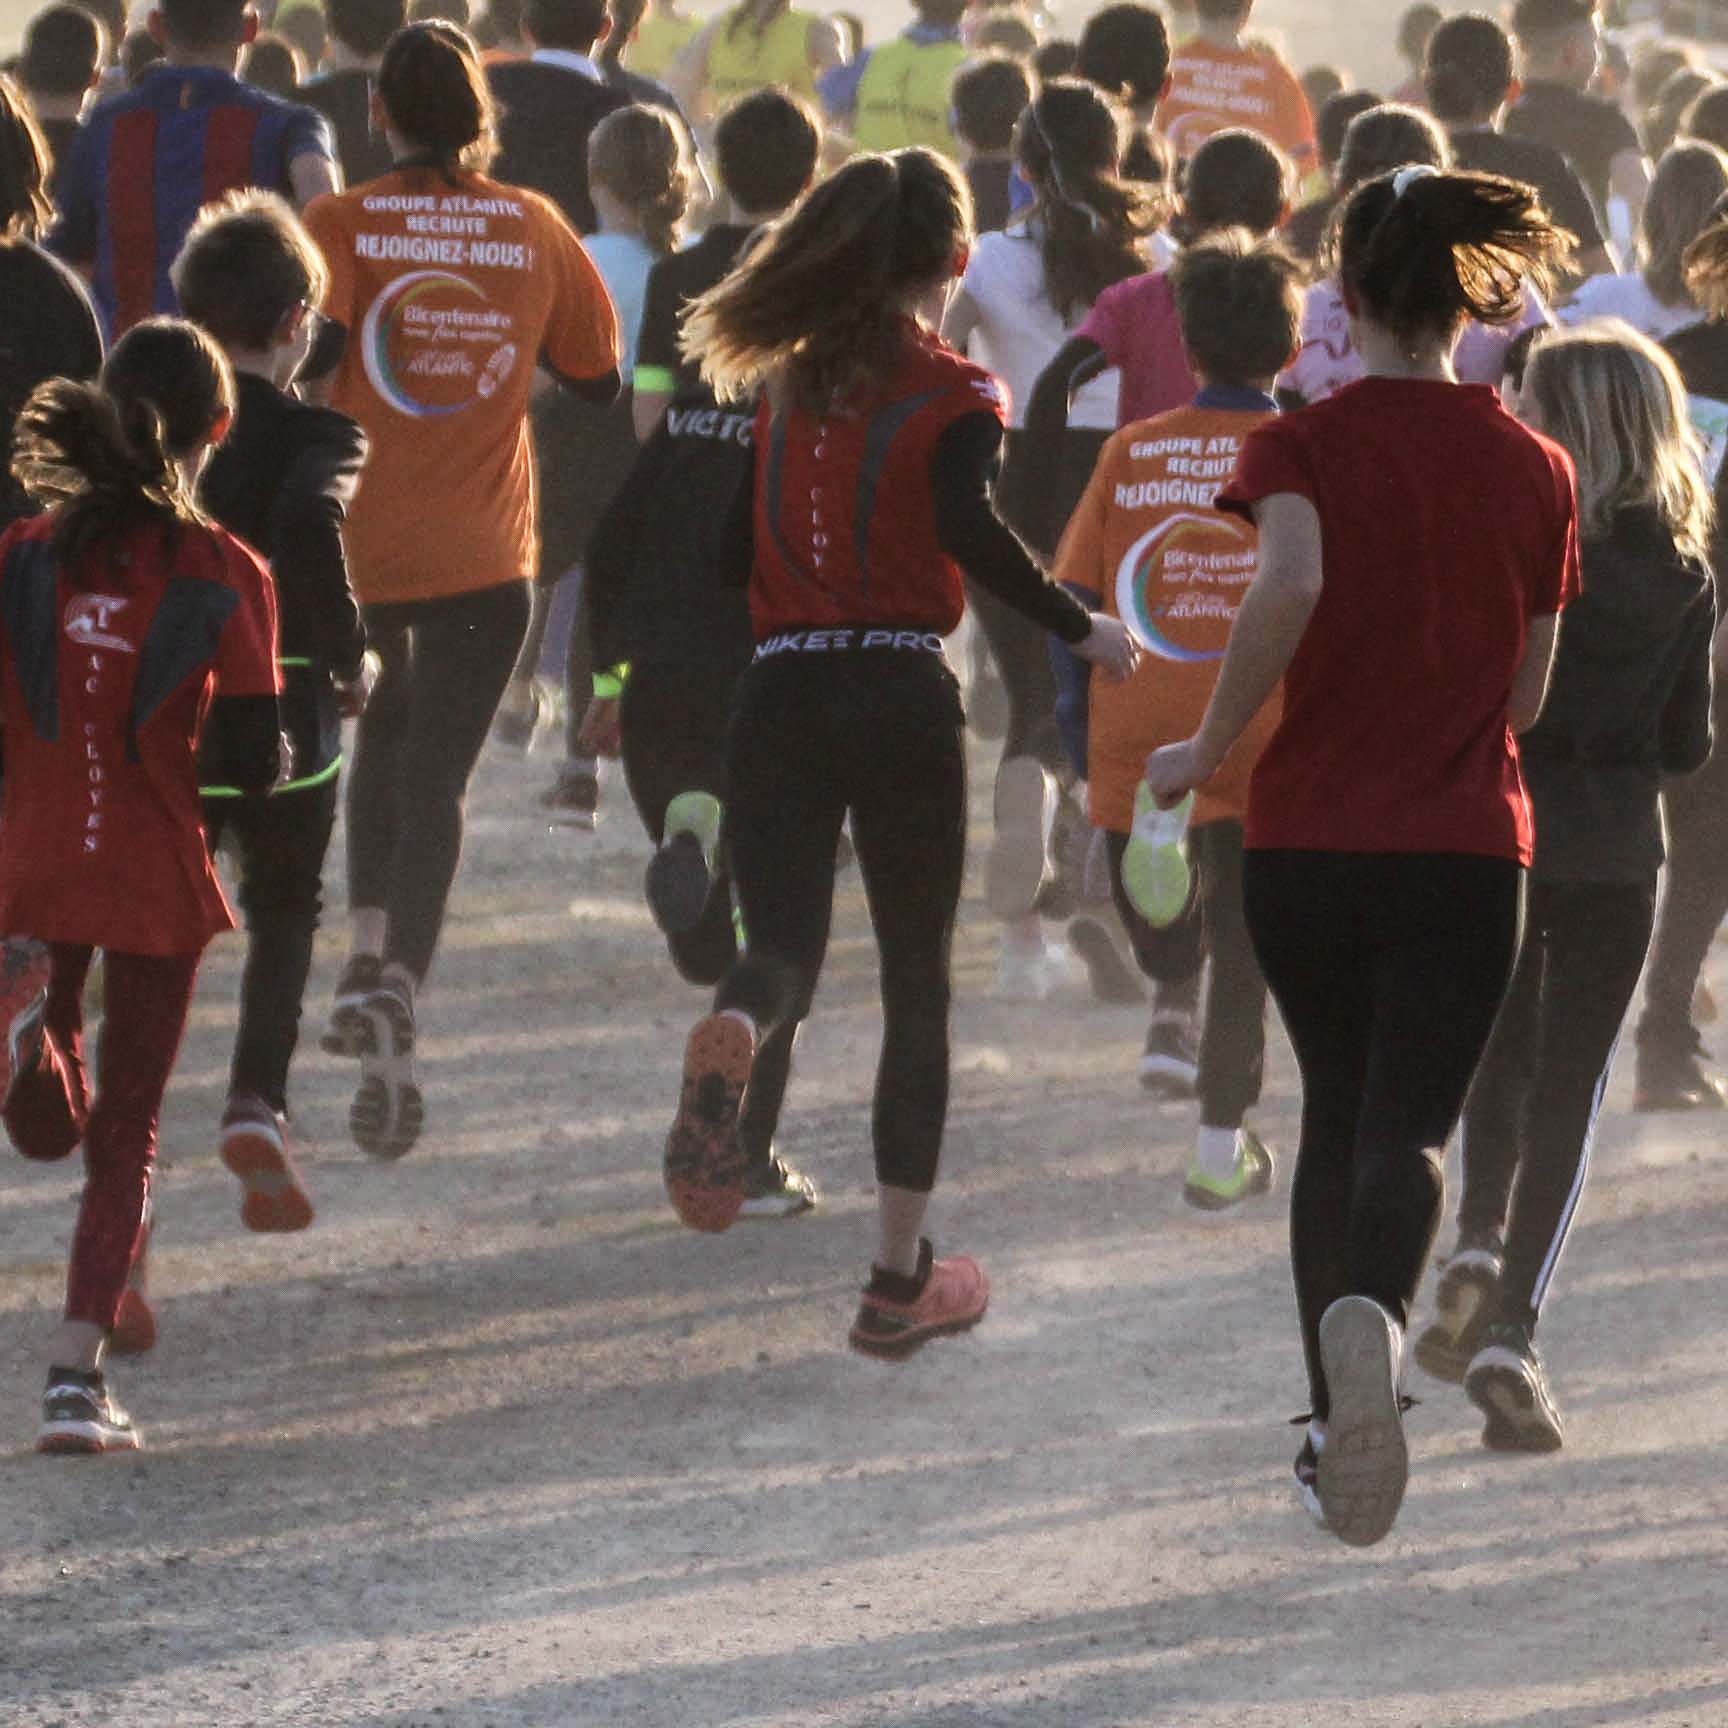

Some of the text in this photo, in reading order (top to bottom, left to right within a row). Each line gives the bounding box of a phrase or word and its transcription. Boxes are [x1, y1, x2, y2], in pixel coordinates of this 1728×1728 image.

[363, 195, 523, 217] GROUPE ATLANTIC
[406, 214, 487, 234] RECRUTE
[355, 233, 524, 269] REJOIGNEZ-NOUS
[403, 304, 513, 329] Bicentenaire
[1129, 438, 1202, 460] GROUPE
[860, 629, 946, 653] PRO
